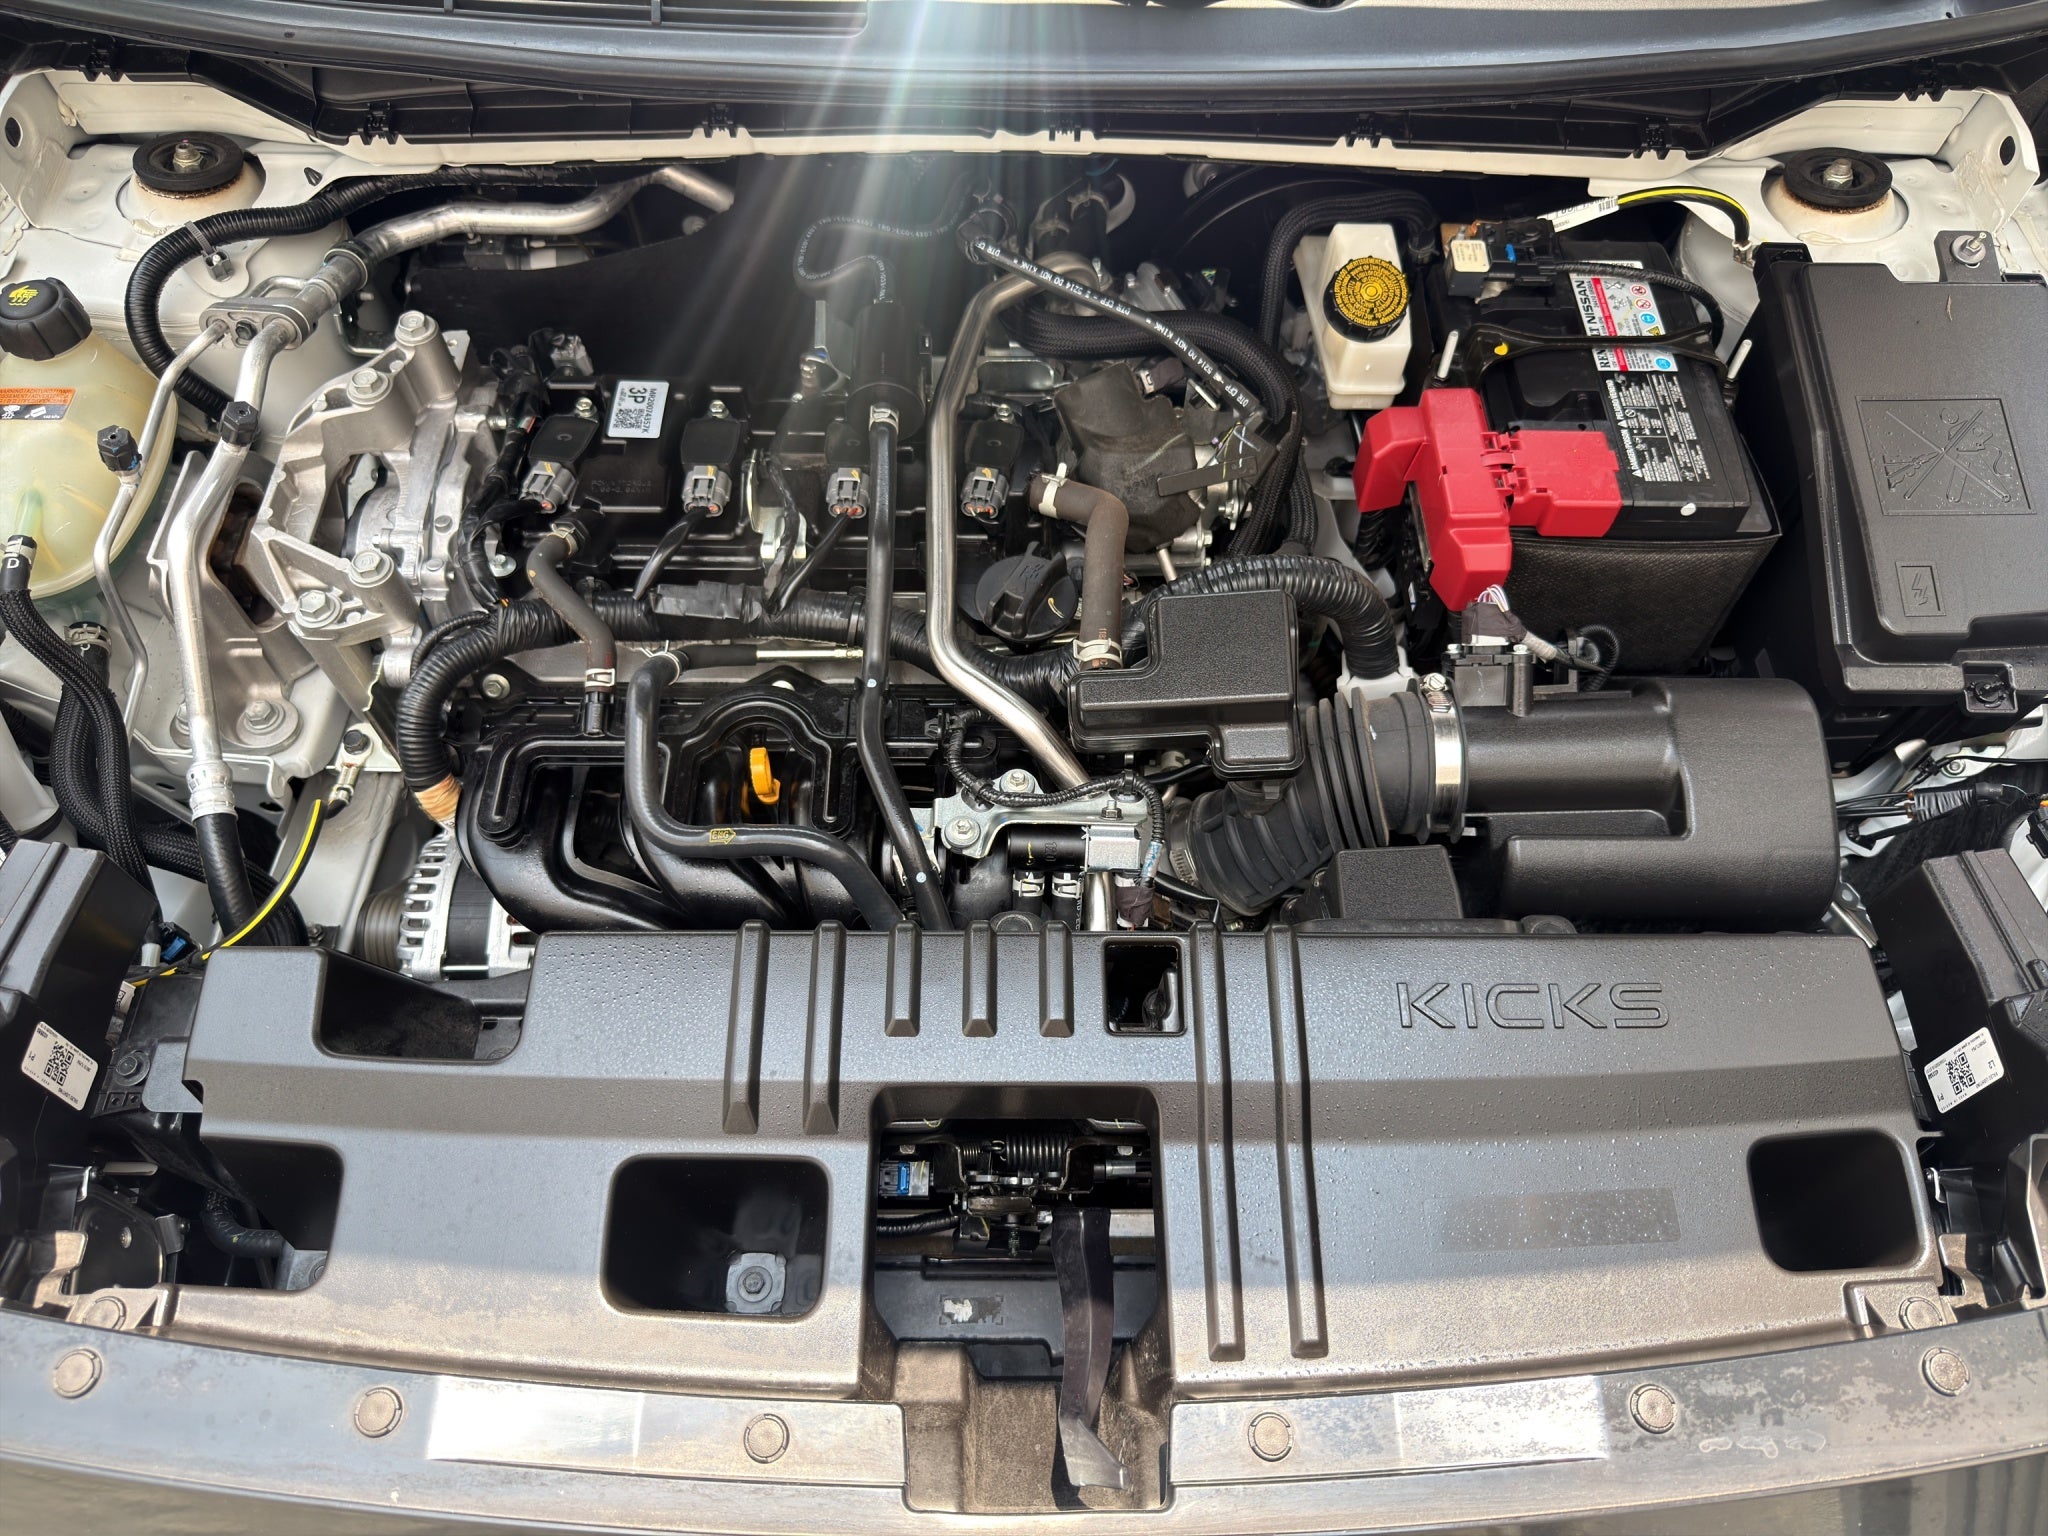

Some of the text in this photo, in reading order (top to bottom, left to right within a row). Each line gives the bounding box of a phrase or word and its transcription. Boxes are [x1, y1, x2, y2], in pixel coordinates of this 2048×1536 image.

[1020, 261, 1038, 274] KINK
[1039, 271, 1053, 282] NOT
[1053, 277, 1065, 287] DO
[1574, 280, 1597, 324] NISSAN
[1153, 321, 1174, 340] KINK
[1174, 337, 1188, 352] NOT
[628, 386, 647, 404] 3P
[6, 557, 20, 569] D
[712, 831, 729, 840] ENG
[1396, 982, 1670, 1029] KICKS
